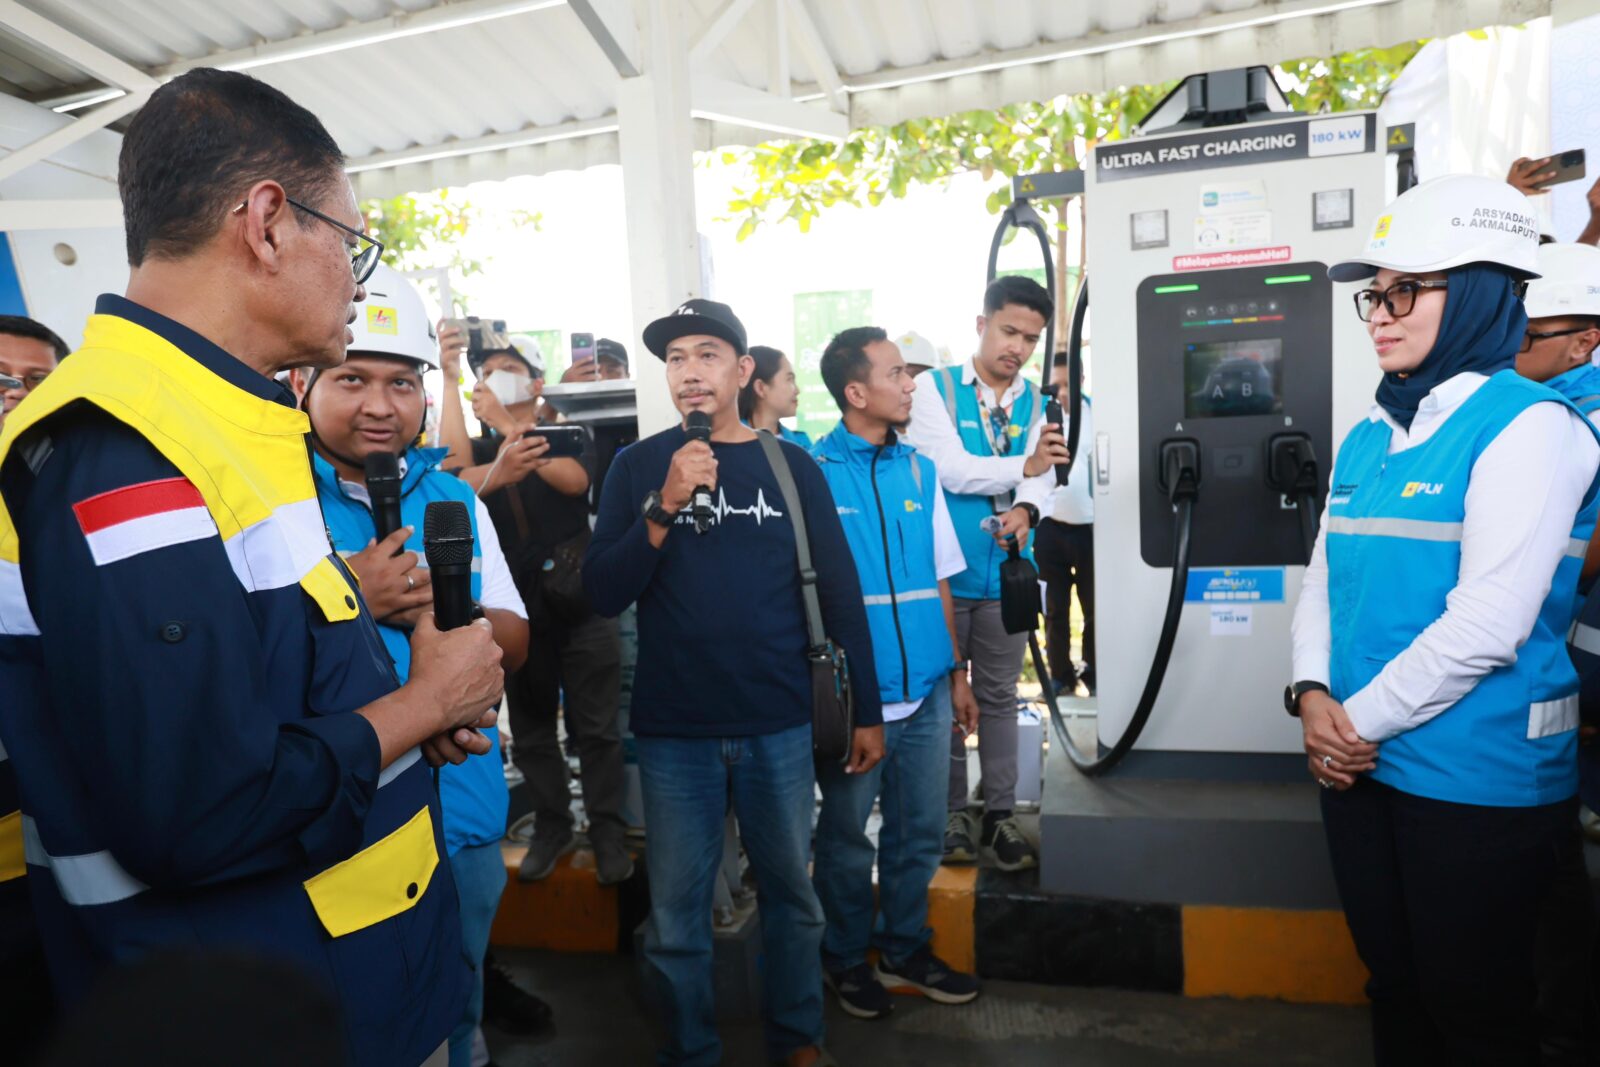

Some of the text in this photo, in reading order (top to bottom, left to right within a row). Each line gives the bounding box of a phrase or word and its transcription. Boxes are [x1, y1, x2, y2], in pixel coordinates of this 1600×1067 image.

[1312, 129, 1362, 143] 180 kW
[1101, 133, 1296, 170] ULTRA FAST CHARGING
[1450, 217, 1465, 227] G.
[1212, 384, 1224, 398] A
[1242, 382, 1252, 397] B
[1175, 422, 1183, 432] A
[1284, 416, 1292, 426] B
[1417, 482, 1444, 495] PLN
